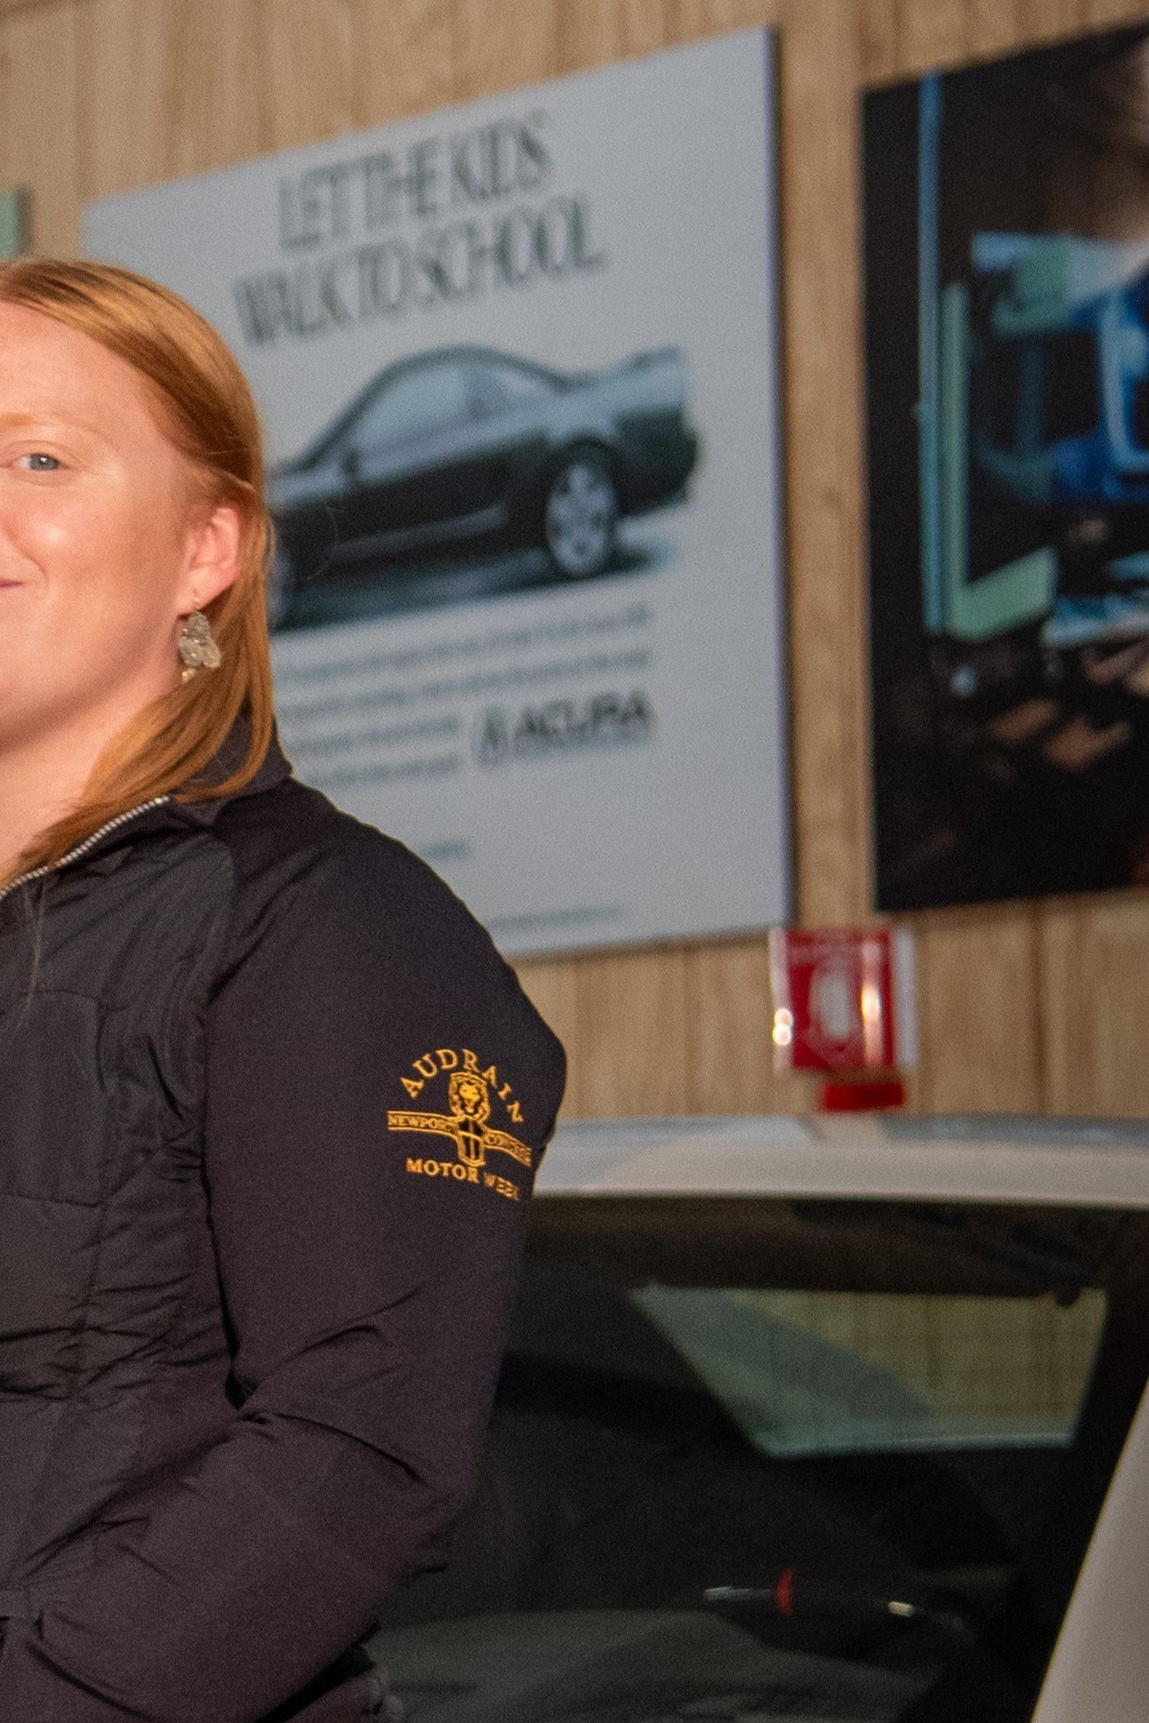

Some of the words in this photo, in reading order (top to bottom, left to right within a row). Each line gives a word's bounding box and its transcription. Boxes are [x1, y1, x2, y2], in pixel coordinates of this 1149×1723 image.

[278, 162, 349, 252] LET
[362, 138, 439, 227] THE
[450, 109, 551, 203] KIDS
[232, 259, 353, 347] WALK
[355, 237, 410, 321] TO
[418, 191, 606, 303] SCHOOL
[515, 690, 654, 739] ACURA
[400, 1048, 524, 1123] AUDRAIN
[405, 1156, 480, 1184] MOTOR
